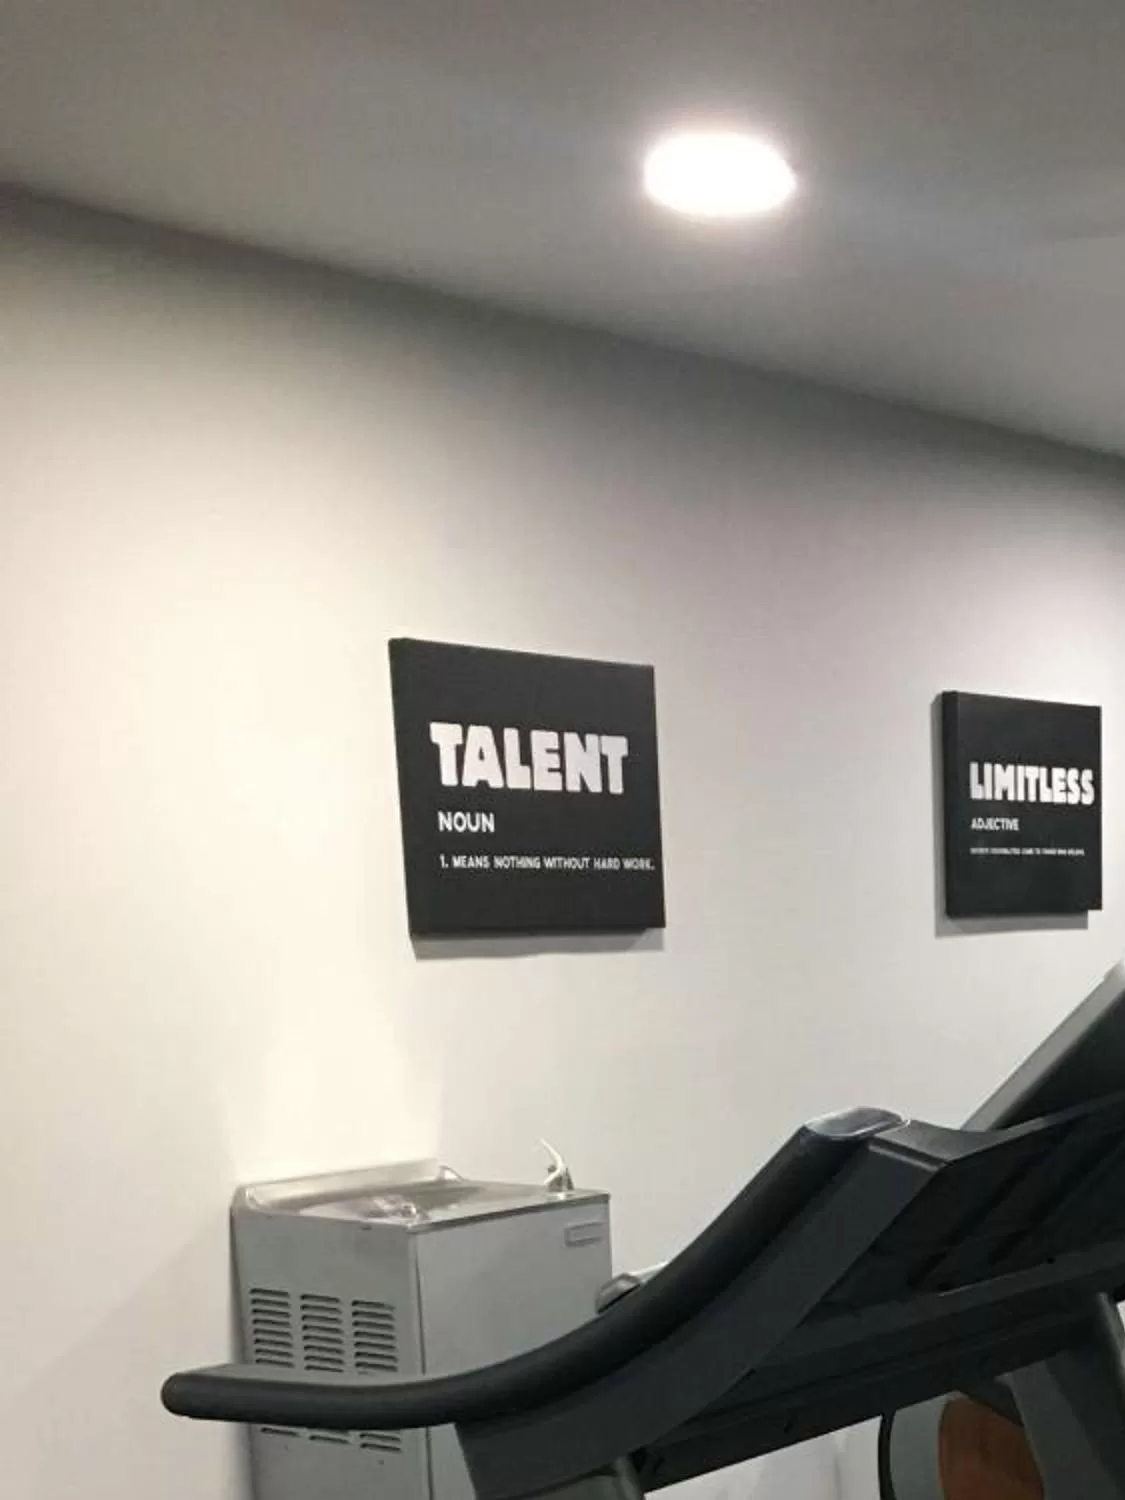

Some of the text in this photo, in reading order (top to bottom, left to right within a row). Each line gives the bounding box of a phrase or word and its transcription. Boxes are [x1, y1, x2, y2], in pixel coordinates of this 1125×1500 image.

[429, 721, 629, 795] TALENT
[969, 761, 1095, 805] LIMITLESS
[437, 811, 495, 833] NOUN
[970, 817, 1020, 831] ADJECTIVE
[439, 853, 449, 869] 1.
[451, 855, 491, 869] MEANS
[493, 855, 542, 870] NOTHING
[543, 856, 591, 870] WITHOUT
[593, 857, 622, 871] HARD
